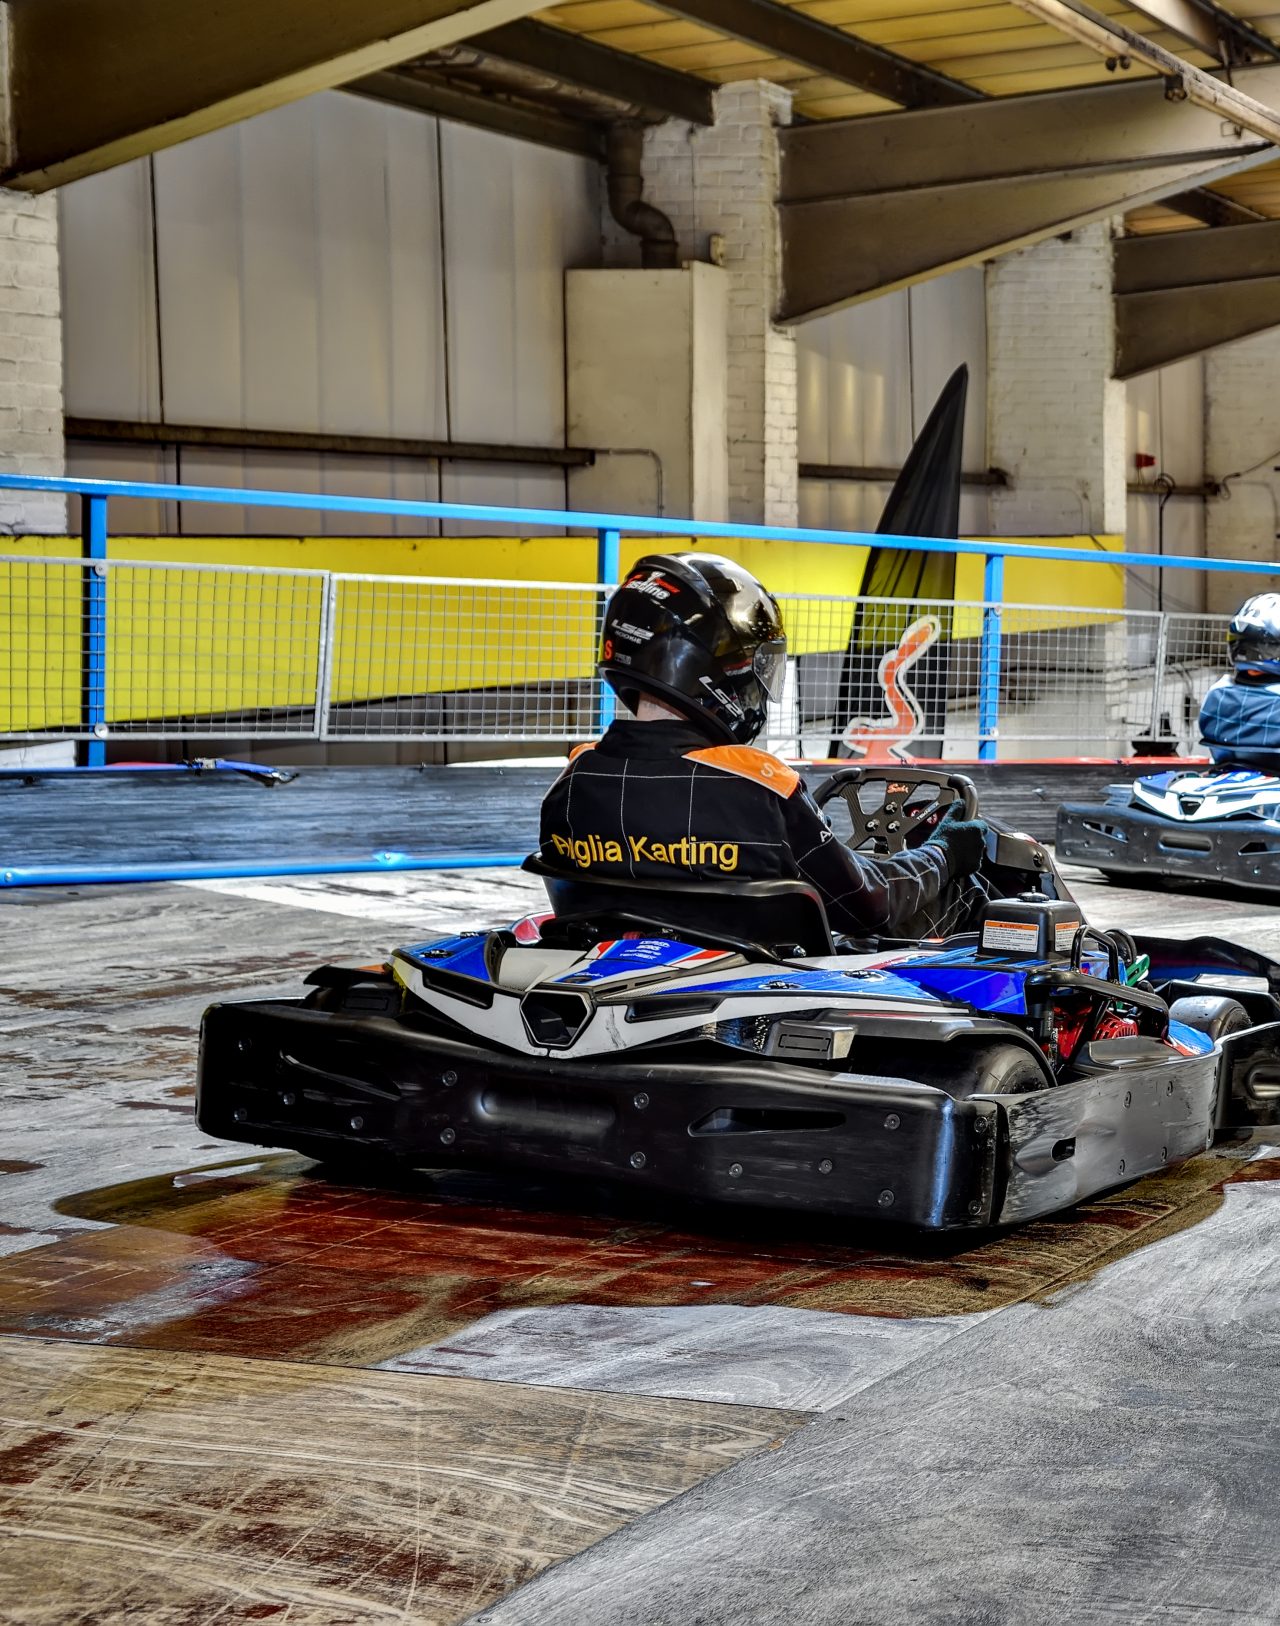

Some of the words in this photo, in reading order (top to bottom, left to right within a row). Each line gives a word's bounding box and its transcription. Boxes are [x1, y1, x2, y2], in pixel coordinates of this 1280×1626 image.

[611, 619, 655, 640] LS2
[699, 676, 745, 721] LS2
[628, 836, 739, 872] Karting
